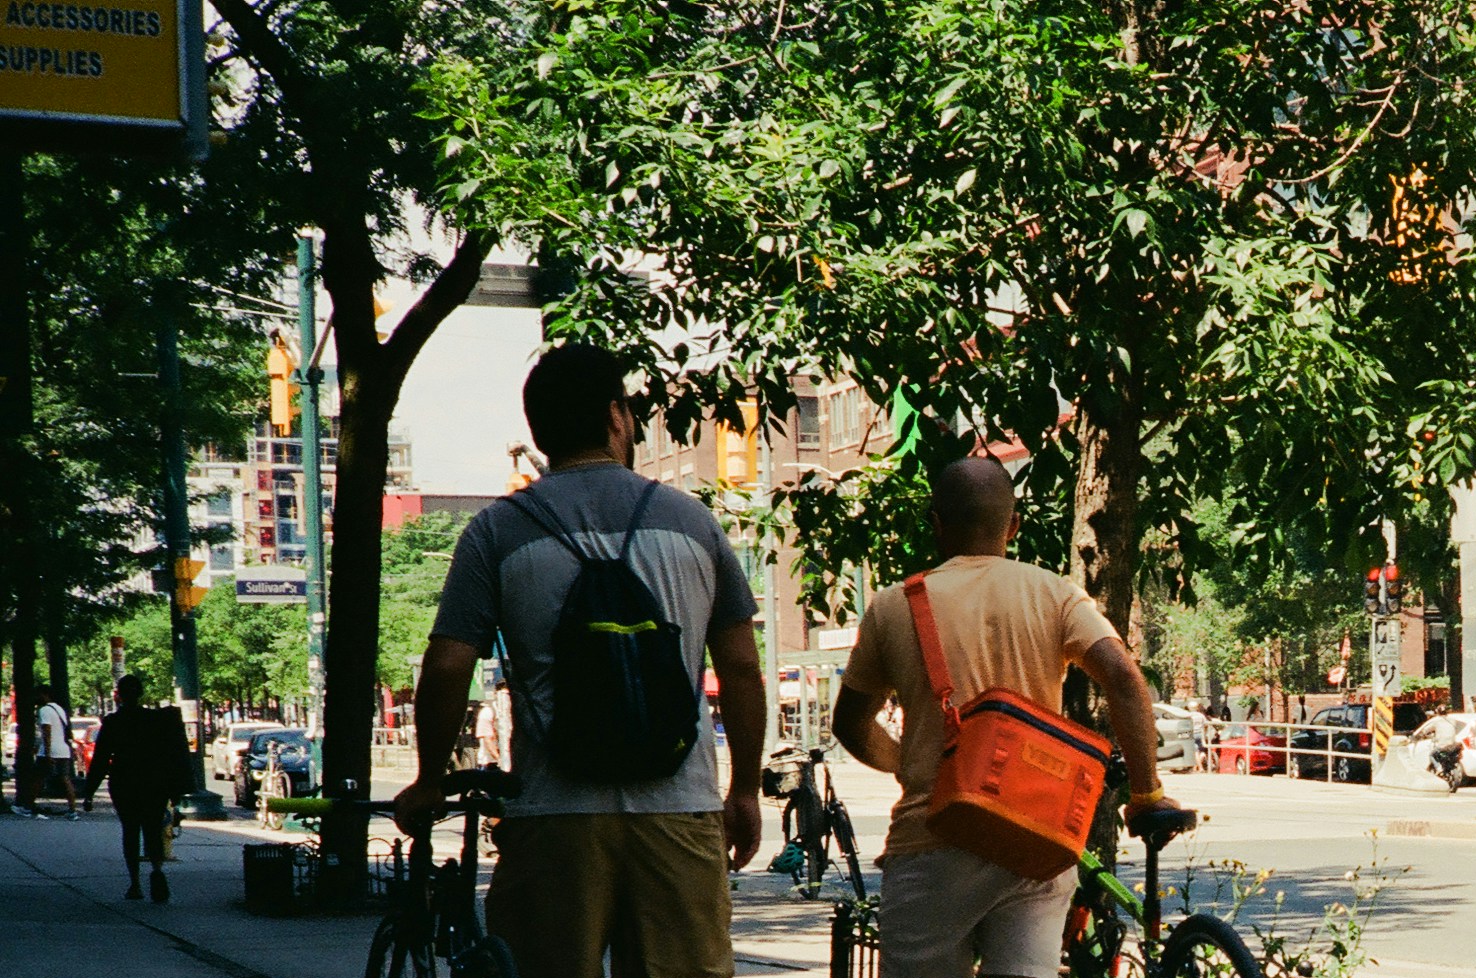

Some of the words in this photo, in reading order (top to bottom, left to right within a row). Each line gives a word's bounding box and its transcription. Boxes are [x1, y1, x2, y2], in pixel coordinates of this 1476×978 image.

[6, 1, 161, 37] ACCESSORIES
[0, 45, 103, 77] SUPPLIES
[245, 581, 285, 593] Sullivan
